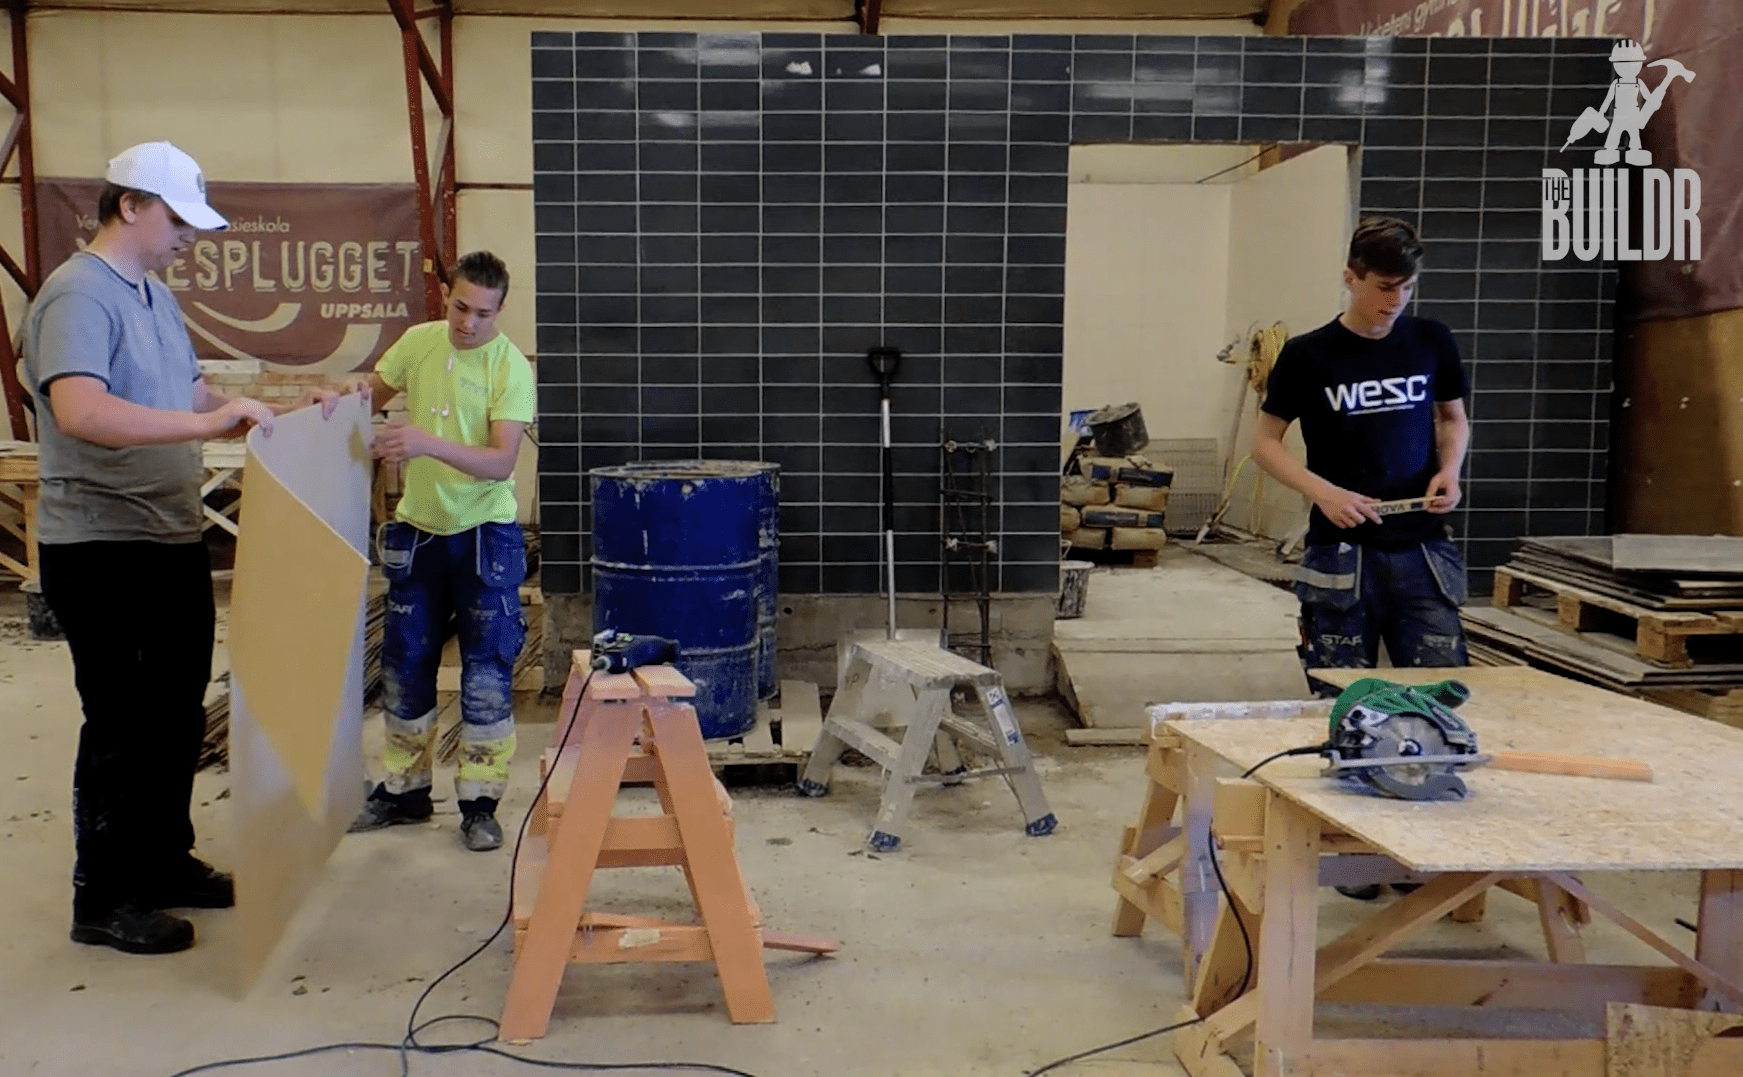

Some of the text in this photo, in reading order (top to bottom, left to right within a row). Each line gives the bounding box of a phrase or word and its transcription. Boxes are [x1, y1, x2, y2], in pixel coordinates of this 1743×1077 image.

[226, 215, 290, 233] sieskola
[164, 240, 420, 292] ESPLUGGET
[319, 302, 409, 319] UPPSALA
